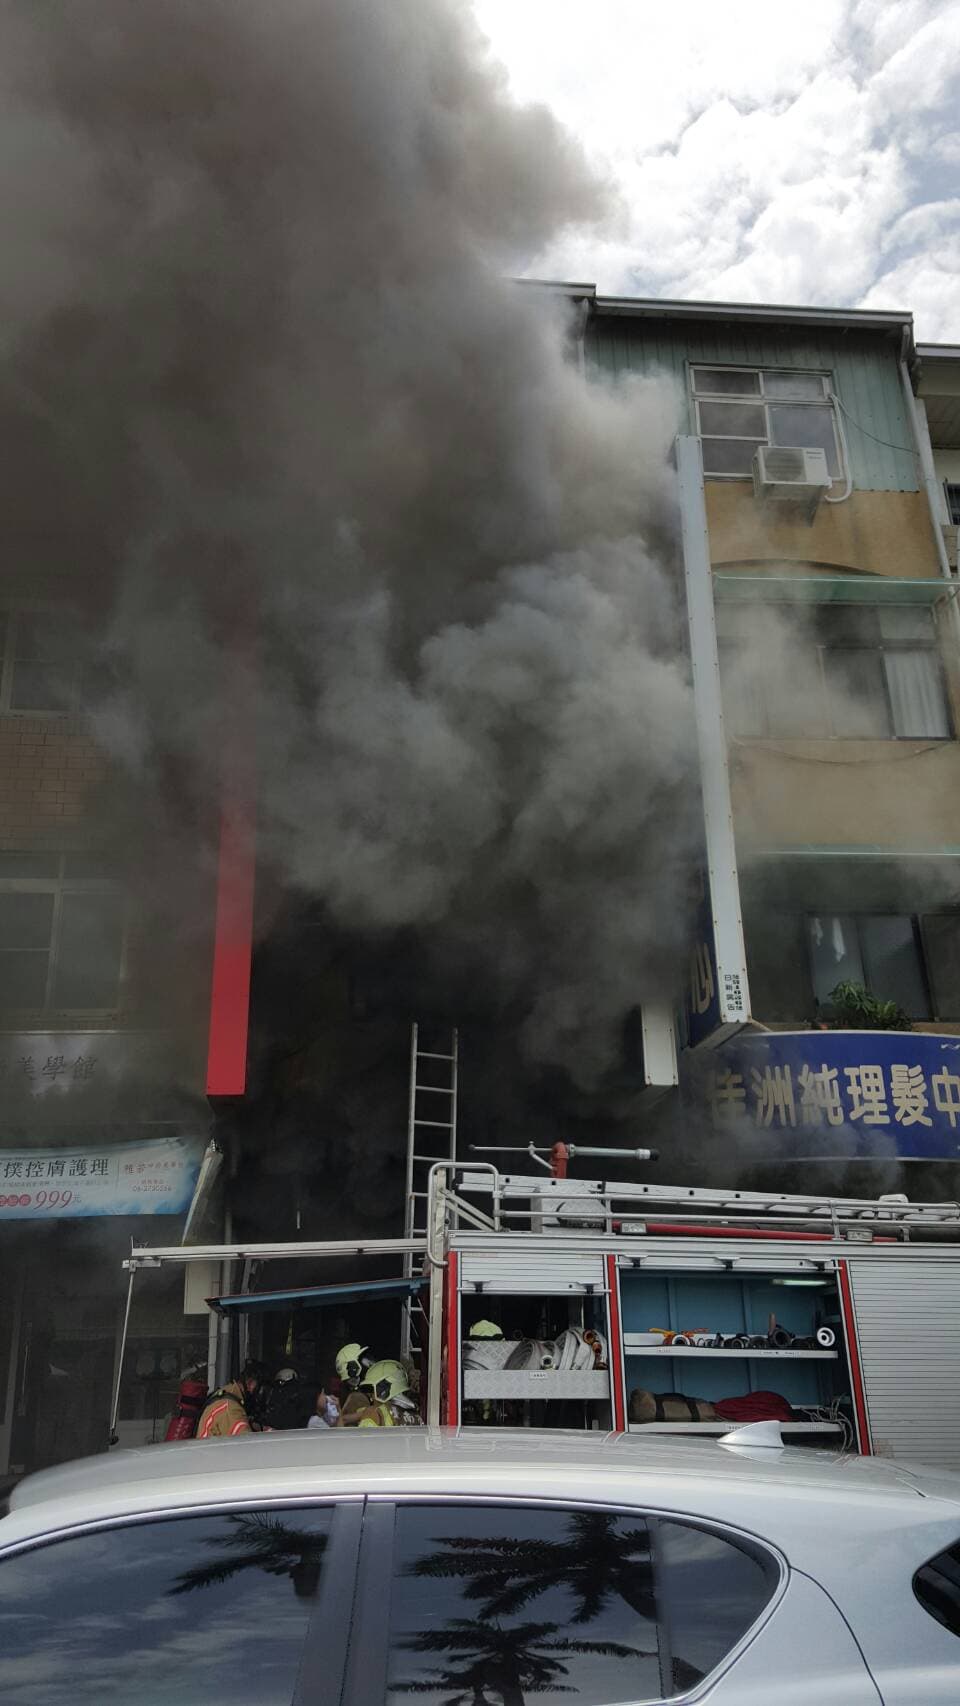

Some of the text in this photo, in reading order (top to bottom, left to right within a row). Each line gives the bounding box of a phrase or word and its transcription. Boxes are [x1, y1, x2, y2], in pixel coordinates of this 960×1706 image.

[0, 1159, 109, 1179] 撲控膚護理
